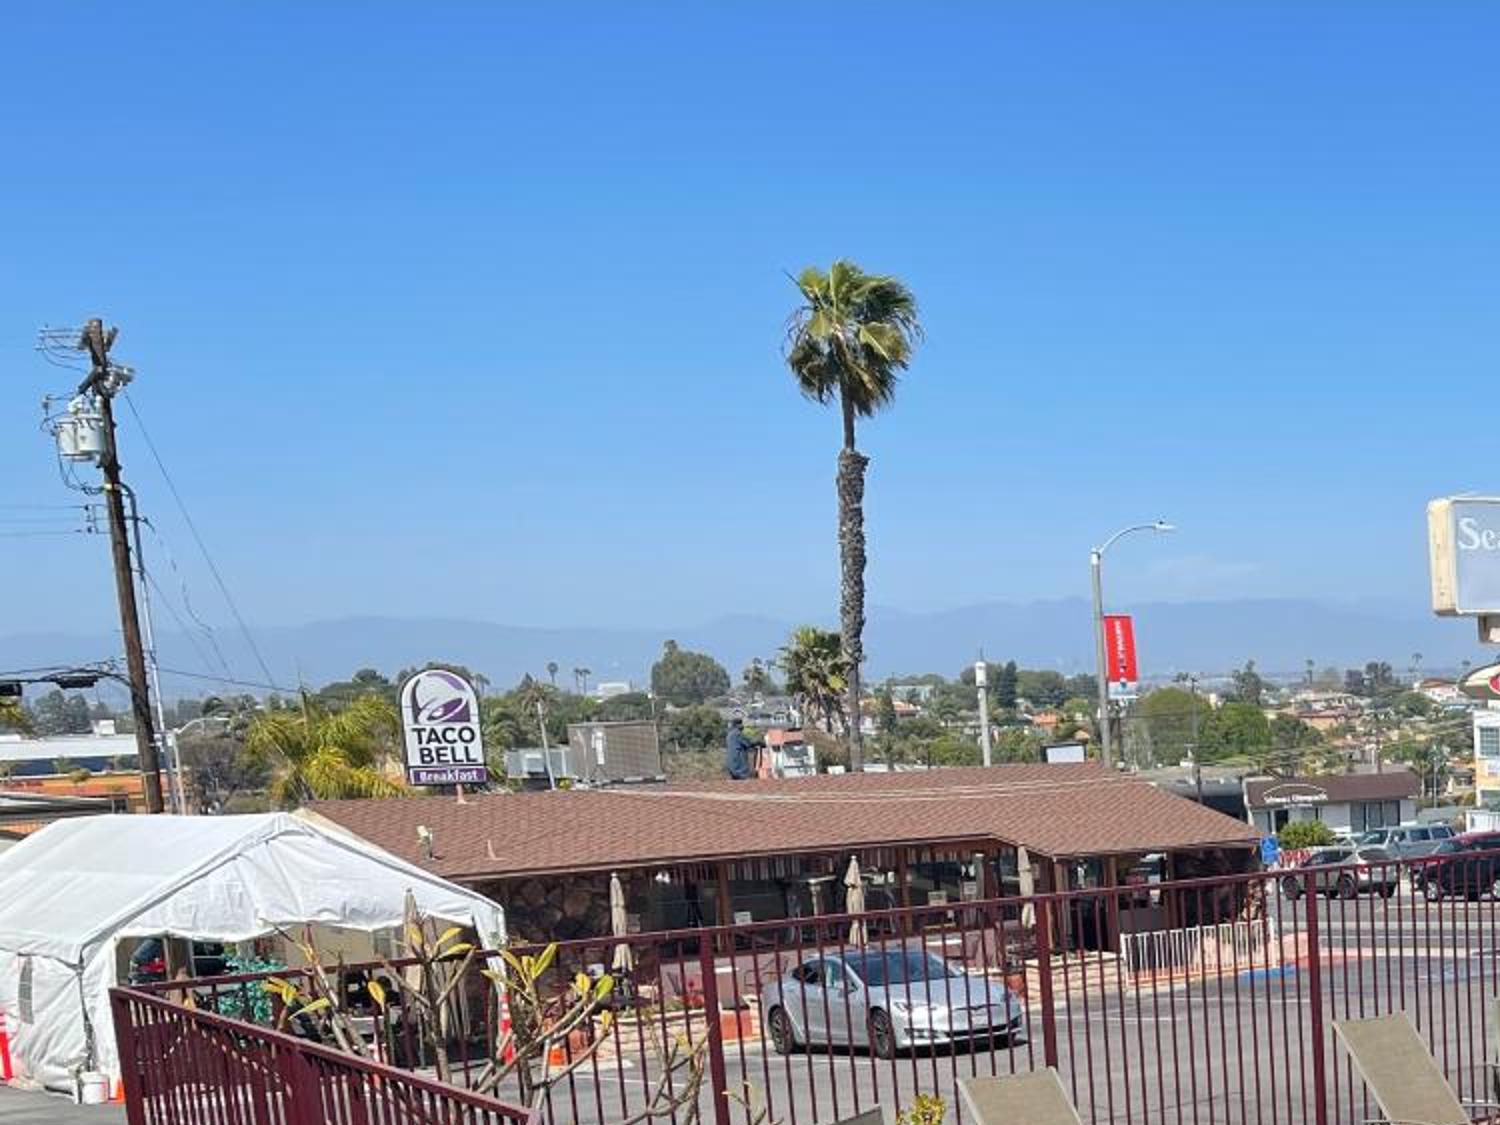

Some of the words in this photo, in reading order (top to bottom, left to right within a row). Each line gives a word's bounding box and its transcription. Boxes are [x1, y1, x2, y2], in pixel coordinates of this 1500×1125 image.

[411, 726, 476, 745] TACO
[419, 746, 478, 765] BELL
[420, 767, 478, 782] Breakfast
